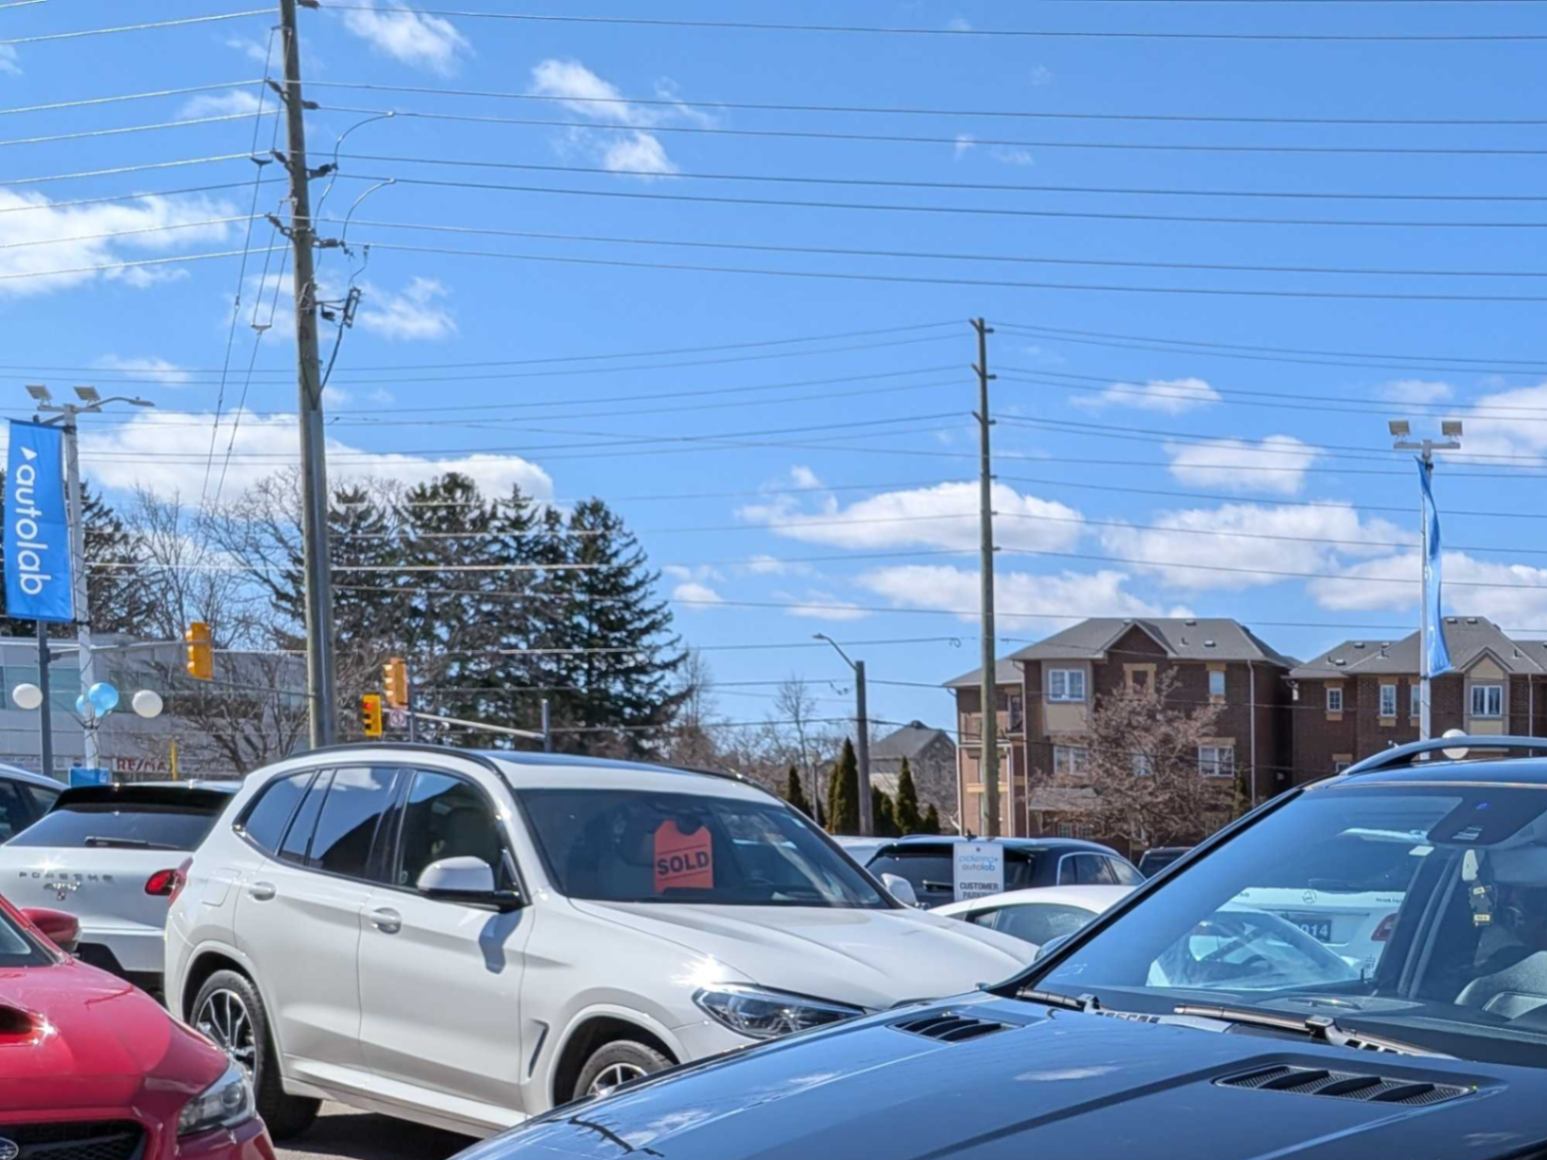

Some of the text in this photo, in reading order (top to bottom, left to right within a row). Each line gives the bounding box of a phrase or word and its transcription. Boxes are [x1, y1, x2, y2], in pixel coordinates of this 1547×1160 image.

[15, 464, 52, 595] autolab
[117, 757, 173, 772] RE/MA
[656, 851, 709, 875] SOLD
[961, 862, 996, 871] autolab
[959, 882, 999, 891] CUSTOMER
[1300, 923, 1329, 937] 014
